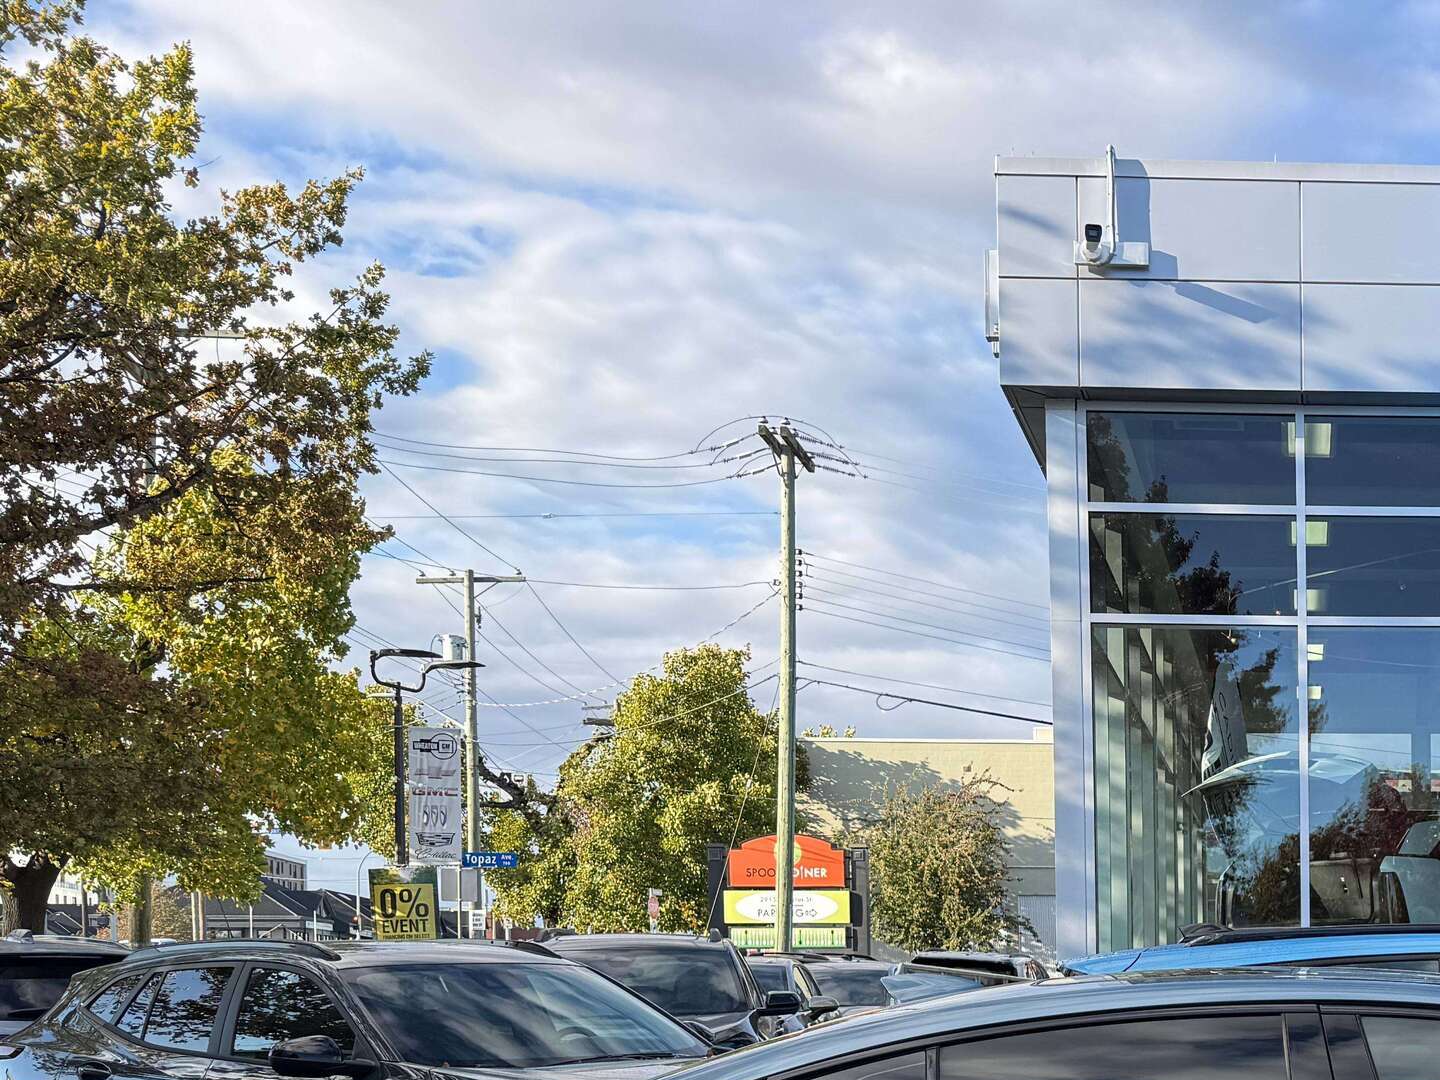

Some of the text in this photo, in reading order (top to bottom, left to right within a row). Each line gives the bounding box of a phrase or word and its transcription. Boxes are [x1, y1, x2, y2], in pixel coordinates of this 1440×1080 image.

[412, 788, 458, 797] GMC
[415, 848, 457, 859] Cadillac
[465, 854, 497, 867] Topaz
[380, 888, 430, 919] 0%
[382, 919, 429, 933] EVENT
